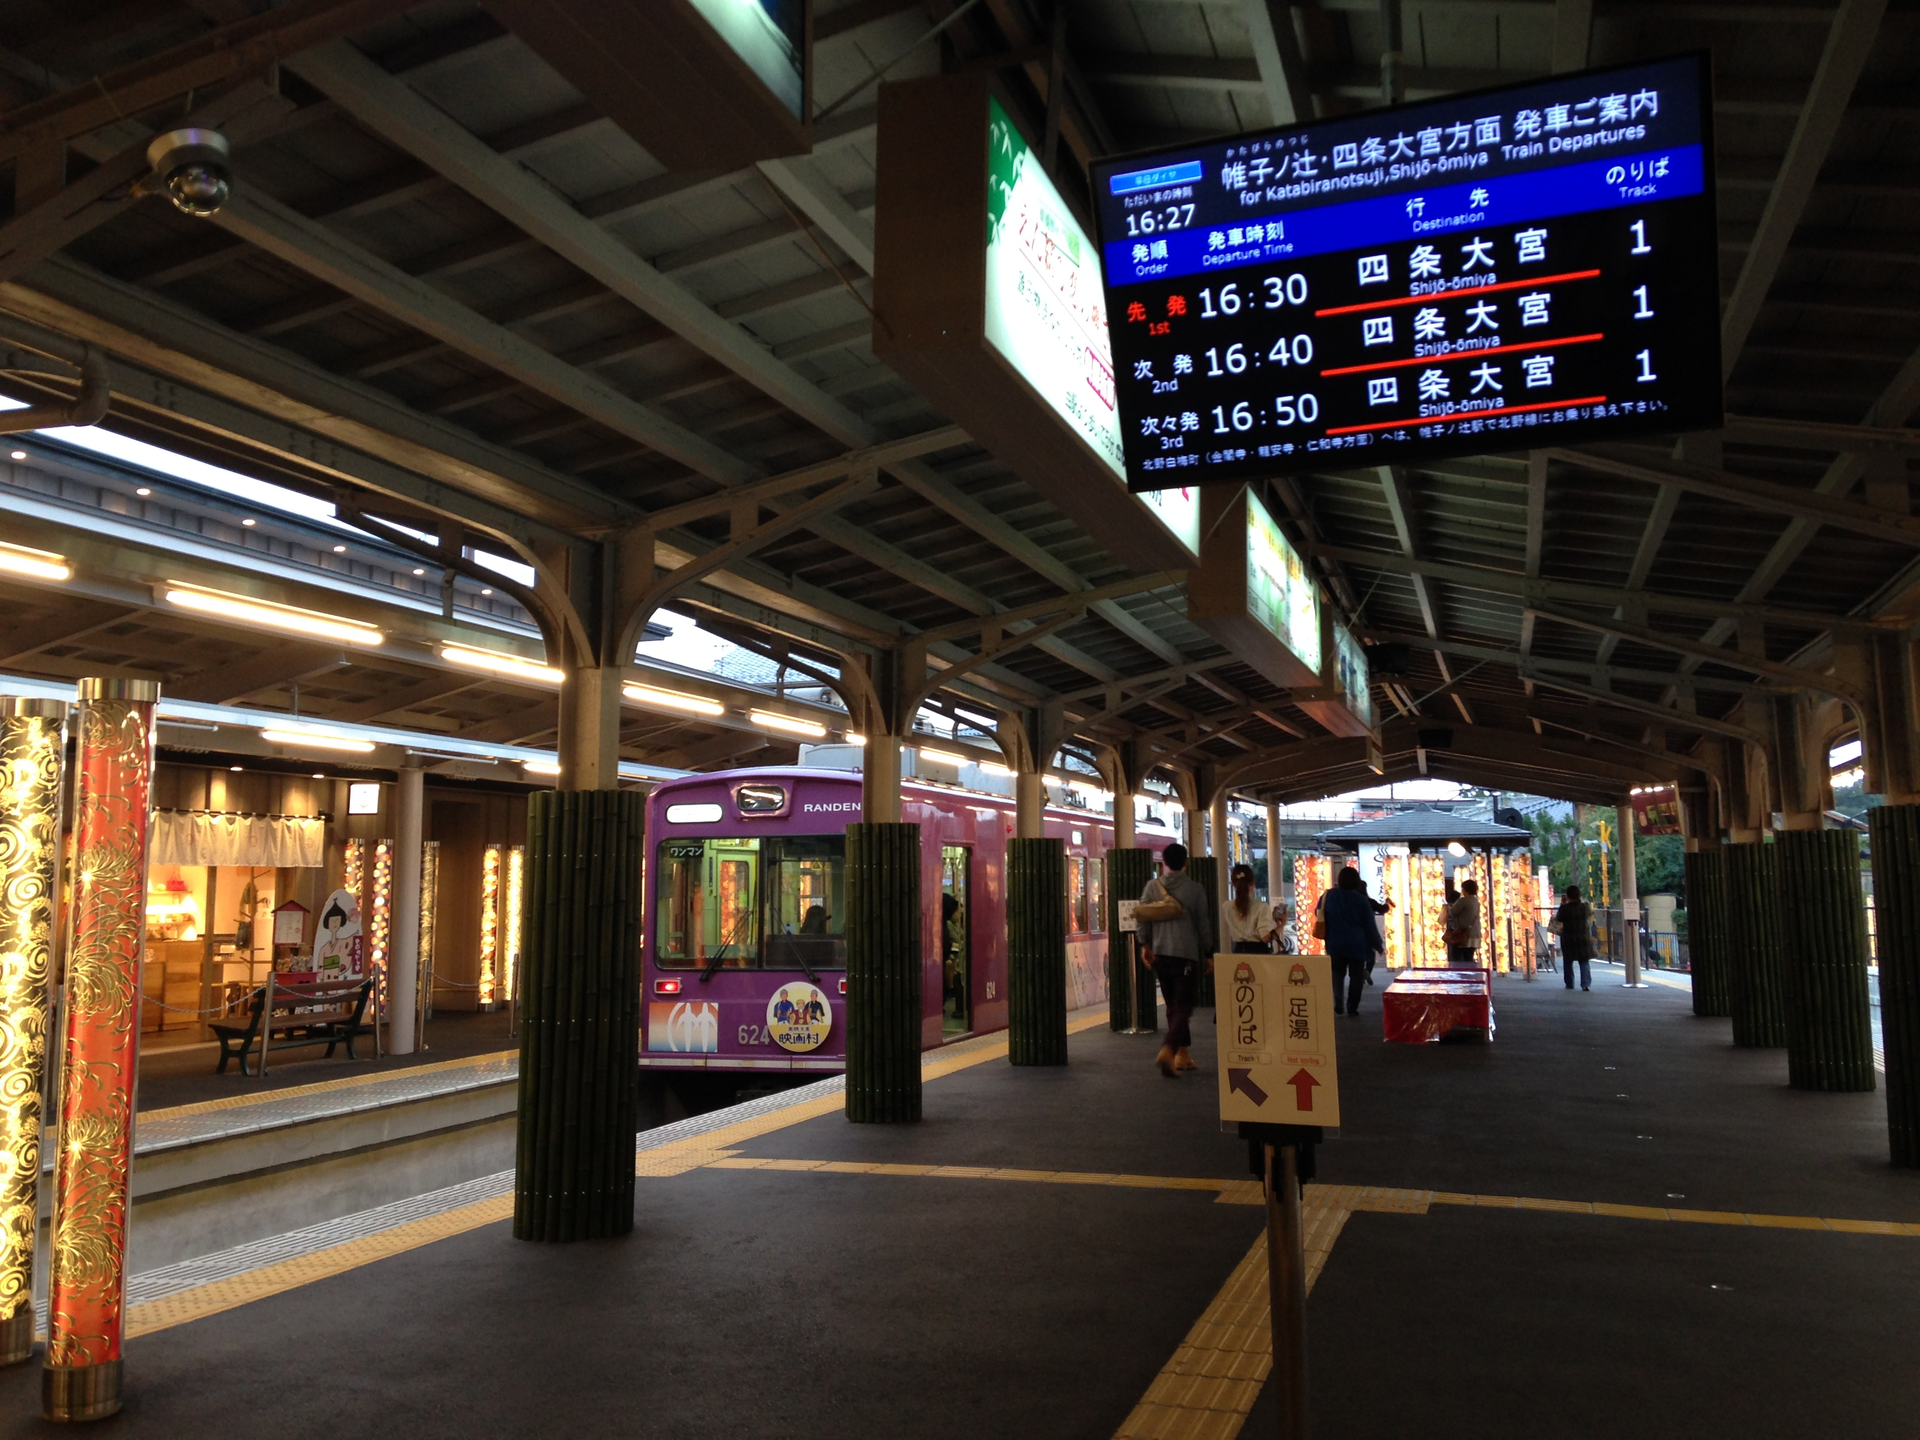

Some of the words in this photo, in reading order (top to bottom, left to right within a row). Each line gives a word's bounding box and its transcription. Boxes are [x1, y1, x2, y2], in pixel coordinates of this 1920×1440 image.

[1513, 88, 1660, 141] 発車ご案内
[1239, 191, 1262, 206] for
[1501, 142, 1543, 161] Train
[1548, 123, 1646, 153] Departures
[1126, 203, 1196, 236] 16:27
[1132, 238, 1169, 263] 発順
[1208, 220, 1285, 251] 発車時刻
[1606, 156, 1671, 185] のりば
[1135, 262, 1169, 276] Order
[1202, 246, 1260, 267] Departure
[1263, 240, 1294, 256] Time
[1413, 209, 1485, 233] Destination
[1619, 183, 1657, 199] Track
[1199, 273, 1308, 319] 16:30
[1629, 219, 1652, 256] 1
[1148, 320, 1170, 335] 1st
[1410, 269, 1497, 297] Shijō-ōmiya
[1206, 333, 1314, 377] 16:40
[1633, 286, 1654, 319] 1
[1141, 411, 1200, 436] 次々発
[1212, 393, 1319, 434] 16:50
[1636, 349, 1656, 382] 1
[1152, 378, 1178, 394] 2nd
[1414, 332, 1501, 358] Shijō-ōmiya
[1160, 436, 1184, 450] 3rd
[1419, 394, 1505, 418] Shijō-ōmiya
[804, 803, 861, 812] RANDEN
[671, 848, 702, 856] ワンマン
[738, 1025, 770, 1044] 624
[779, 1033, 819, 1044] 映画村
[1236, 985, 1257, 1045] のりば
[1289, 998, 1310, 1039] 足湯
